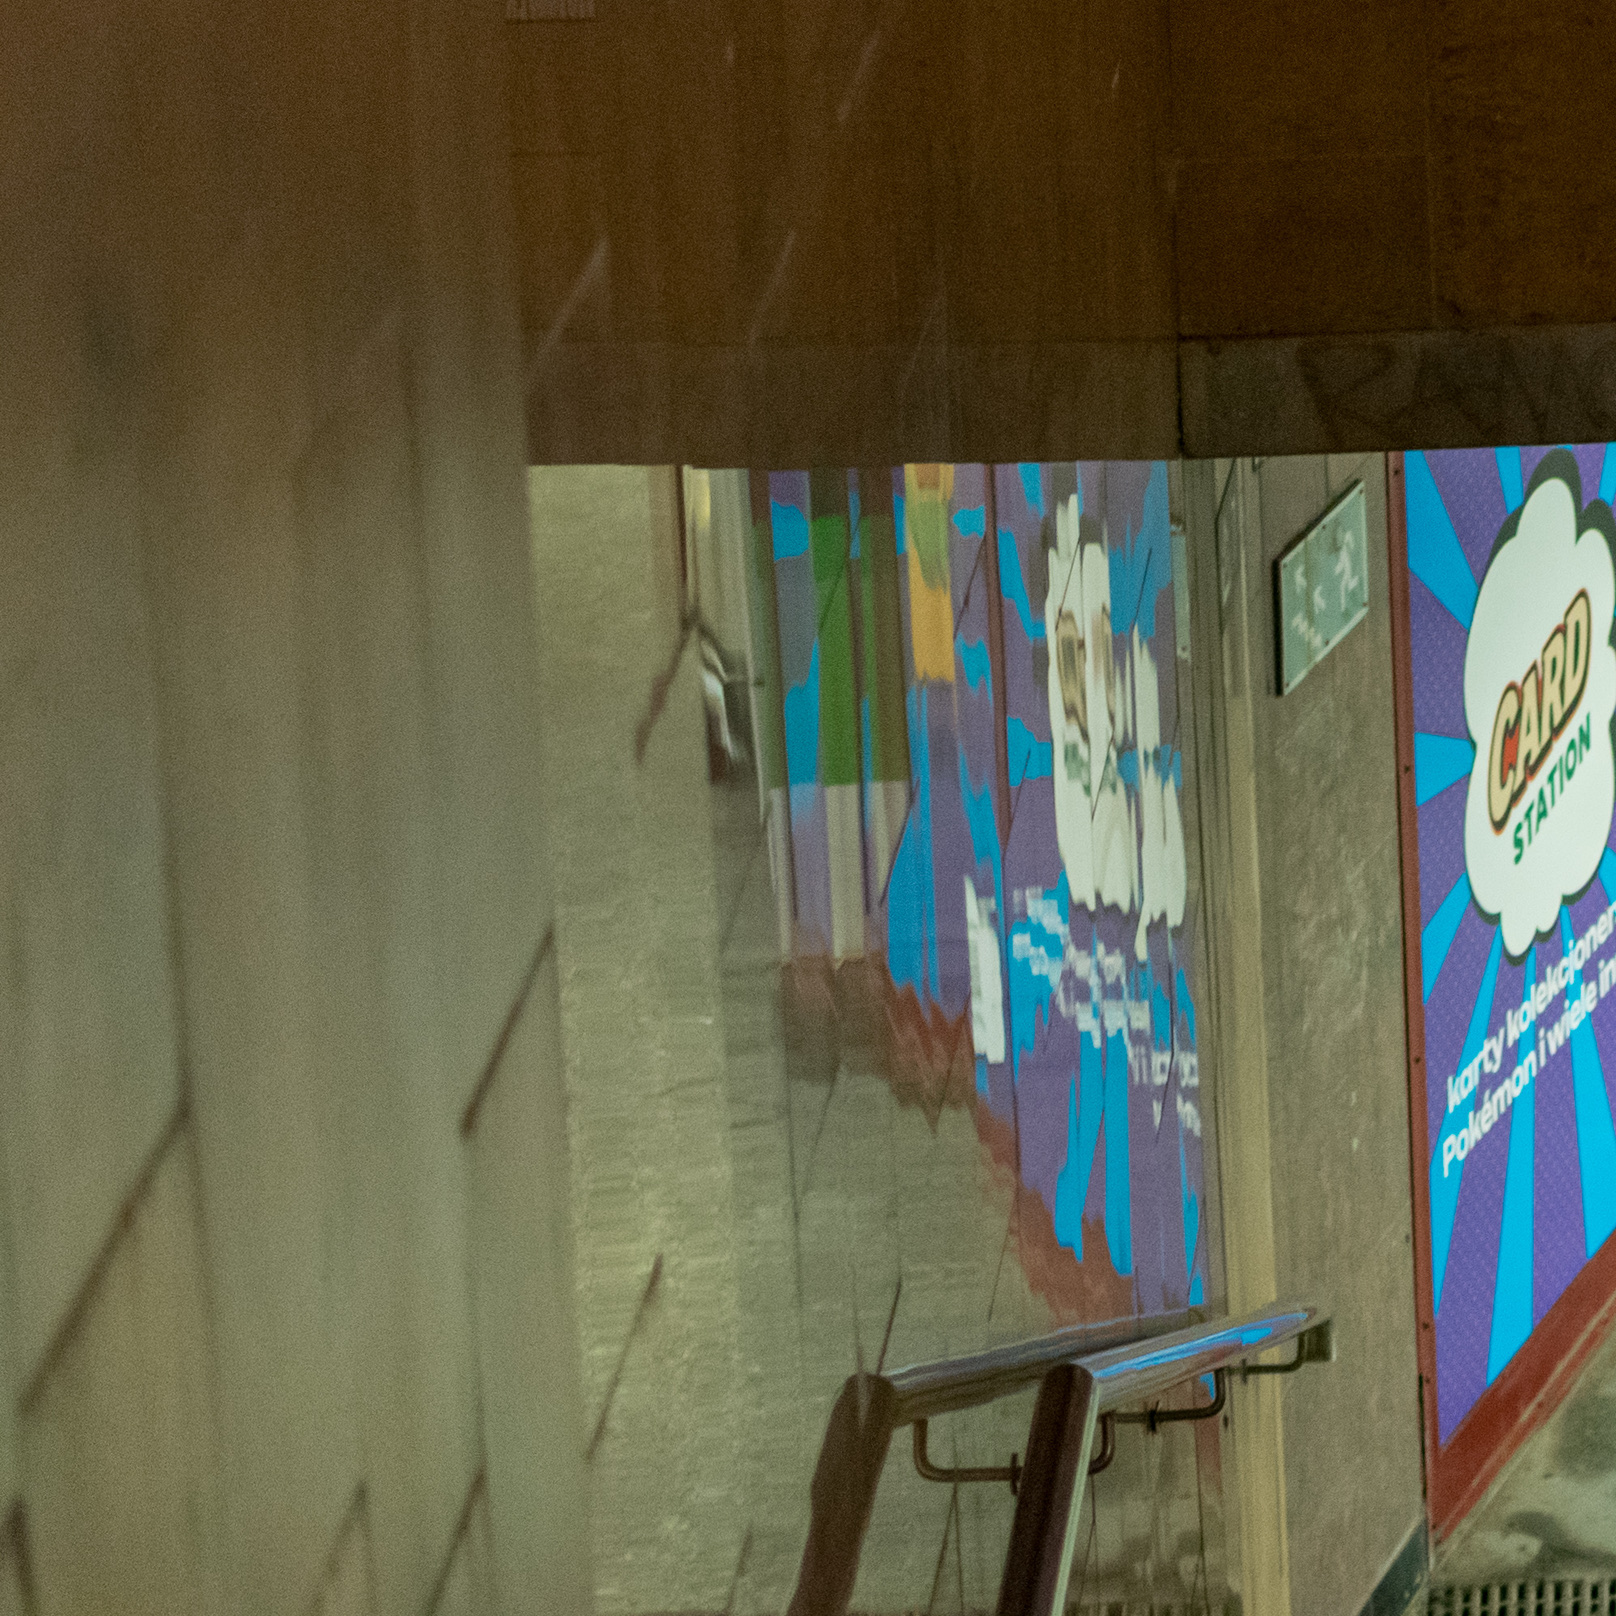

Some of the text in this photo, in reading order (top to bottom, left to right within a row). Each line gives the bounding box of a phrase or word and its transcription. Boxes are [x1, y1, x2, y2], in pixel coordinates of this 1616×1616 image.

[1487, 587, 1593, 837] CARD
[1512, 711, 1592, 866] STATION
[1441, 1049, 1538, 1179] Pokémon
[1538, 1027, 1547, 1068] i
[1546, 981, 1598, 1056] wiele
[1446, 1026, 1506, 1114] karty
